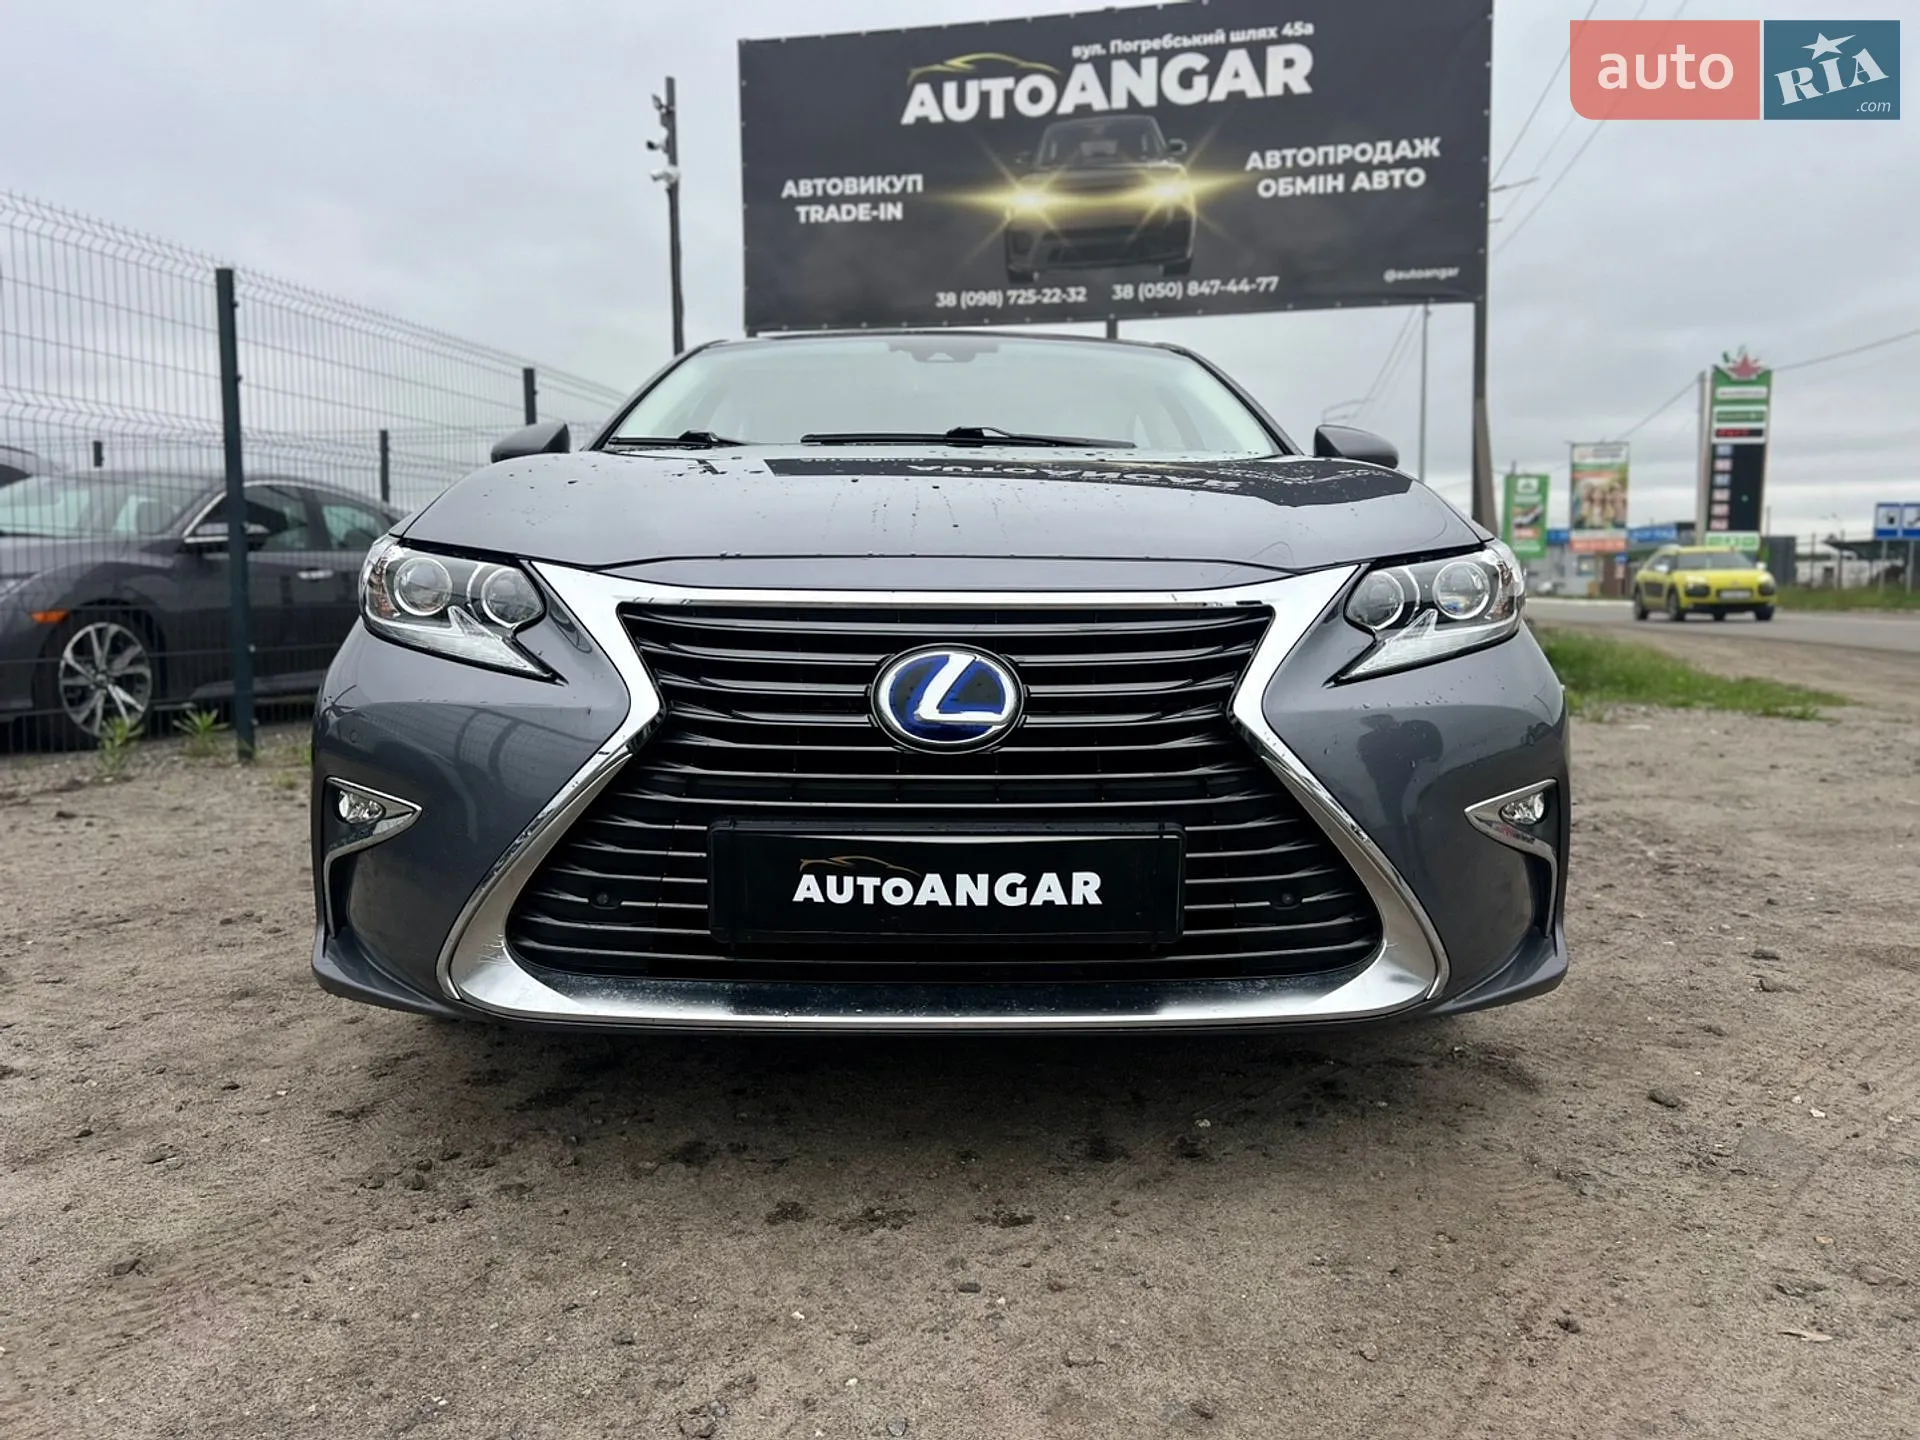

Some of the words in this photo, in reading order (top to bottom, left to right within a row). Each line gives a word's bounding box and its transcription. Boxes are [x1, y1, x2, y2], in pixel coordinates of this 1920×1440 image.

[1072, 44, 1106, 60] вул.
[1110, 29, 1225, 54] Погребський
[1229, 26, 1278, 43] шлях
[901, 43, 1313, 125] AUTOANGAR
[1245, 137, 1441, 171] АВТОПРОДАЖ
[781, 173, 924, 199] АВТОВИКУП
[1257, 173, 1345, 198] ОБМІН
[1351, 167, 1427, 193] АВТО
[795, 201, 904, 224] TRADE-IN
[935, 291, 957, 307] 38
[960, 289, 1003, 310] (098)
[1006, 286, 1088, 305] 725-22-32
[1112, 283, 1135, 300] 38
[1138, 280, 1184, 302] (050)
[1186, 275, 1280, 296] 847-44-77
[792, 872, 1103, 906] AUTOANGAR
